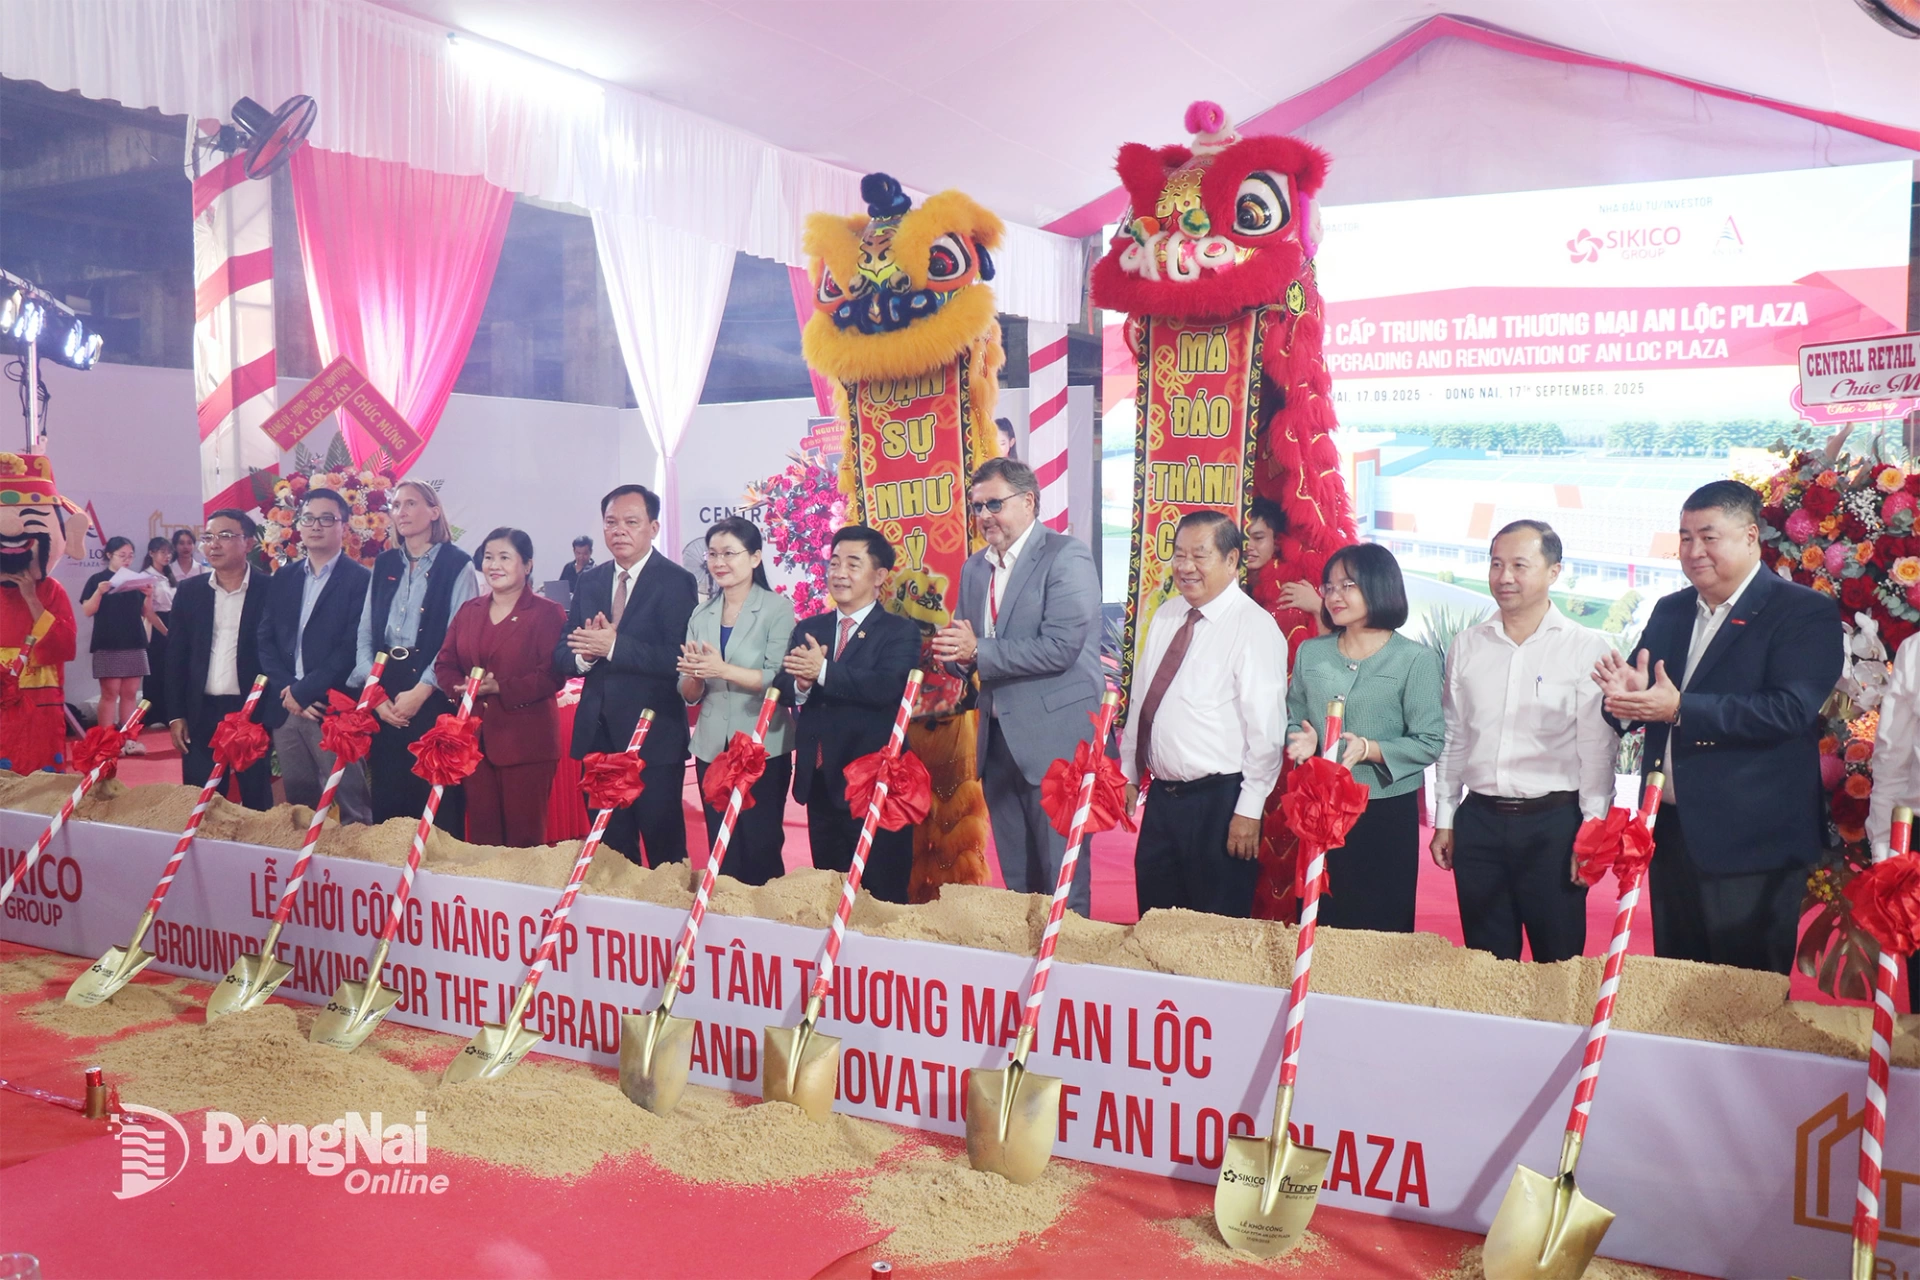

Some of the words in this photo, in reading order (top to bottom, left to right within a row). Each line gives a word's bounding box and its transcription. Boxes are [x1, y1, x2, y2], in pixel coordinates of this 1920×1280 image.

[1606, 226, 1681, 249] SIKICO
[1621, 248, 1666, 260] GROUP
[1336, 316, 1376, 345] CẤP
[1380, 318, 1448, 344] TRUNG
[1452, 314, 1498, 340] TÂM
[1594, 310, 1638, 337] MẠI
[1642, 307, 1676, 333] AN
[1680, 302, 1726, 333] LỘC
[1730, 302, 1809, 329] PLAZA
[1179, 325, 1228, 373] MÃ
[1416, 348, 1452, 370] AND
[1455, 344, 1564, 368] RENOVATION
[1568, 343, 1591, 364] OF
[1595, 343, 1622, 362] AN
[1625, 341, 1661, 362] LOC
[1665, 338, 1729, 360] PLAZA
[1806, 348, 1864, 377] CENTRAL
[1868, 343, 1916, 371] RETAIL
[353, 393, 382, 423] CHÚC
[1357, 388, 1420, 401] 17.09.2025
[1446, 387, 1475, 400] DONG
[1614, 381, 1645, 395] 2025
[1830, 378, 1881, 399] Chúc
[289, 421, 308, 440] XÃ
[305, 403, 330, 425] LỘC
[327, 383, 352, 405] TẤN
[1171, 390, 1231, 437] ĐÁO
[882, 413, 936, 462] SỰ
[874, 474, 954, 521] NHƯ
[1152, 456, 1237, 505] THÀNH
[904, 528, 928, 571] Ý
[0, 847, 83, 903] IKICO
[4, 895, 63, 927] GROUP
[250, 857, 278, 921] LỄ
[431, 895, 510, 962] NÂNG
[586, 926, 695, 995] TRUNG
[704, 938, 783, 1011] TÂM
[793, 958, 948, 1038] THƯƠNG
[1052, 998, 1111, 1064] AN
[1128, 999, 1212, 1087] LỘC
[435, 971, 489, 1028] THE
[688, 1020, 758, 1083] AND
[1093, 1090, 1153, 1159] AN
[1238, 1172, 1266, 1186] SIKICO
